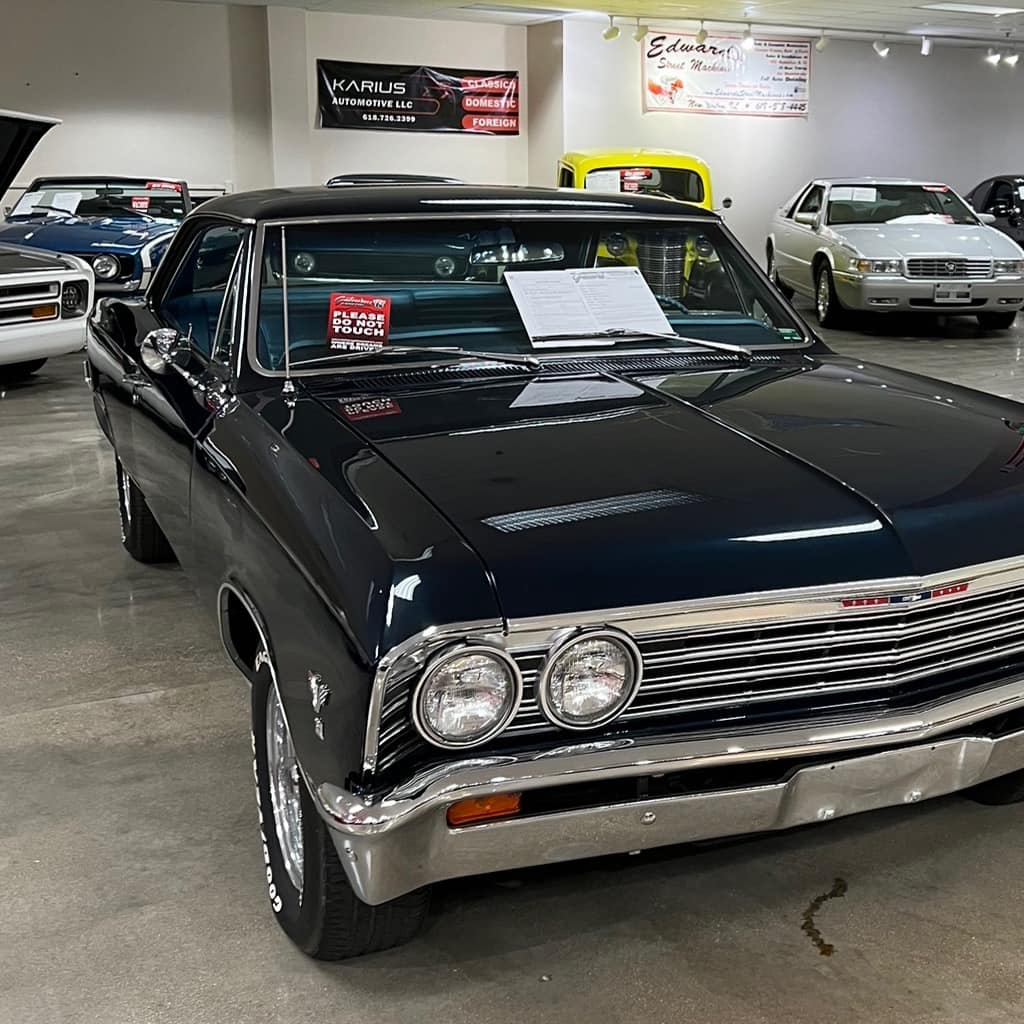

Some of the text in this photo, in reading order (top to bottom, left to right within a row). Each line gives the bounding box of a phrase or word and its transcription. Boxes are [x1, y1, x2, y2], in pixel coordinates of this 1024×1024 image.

[333, 78, 406, 94] KARIUS
[332, 97, 413, 109] AUTOMOTIVE LLC
[465, 98, 516, 109] DOMESTIC
[472, 117, 517, 128] FOREIGN
[333, 311, 385, 321] PLEASE
[333, 318, 385, 329] DO NOT
[332, 326, 385, 337] TOUCH
